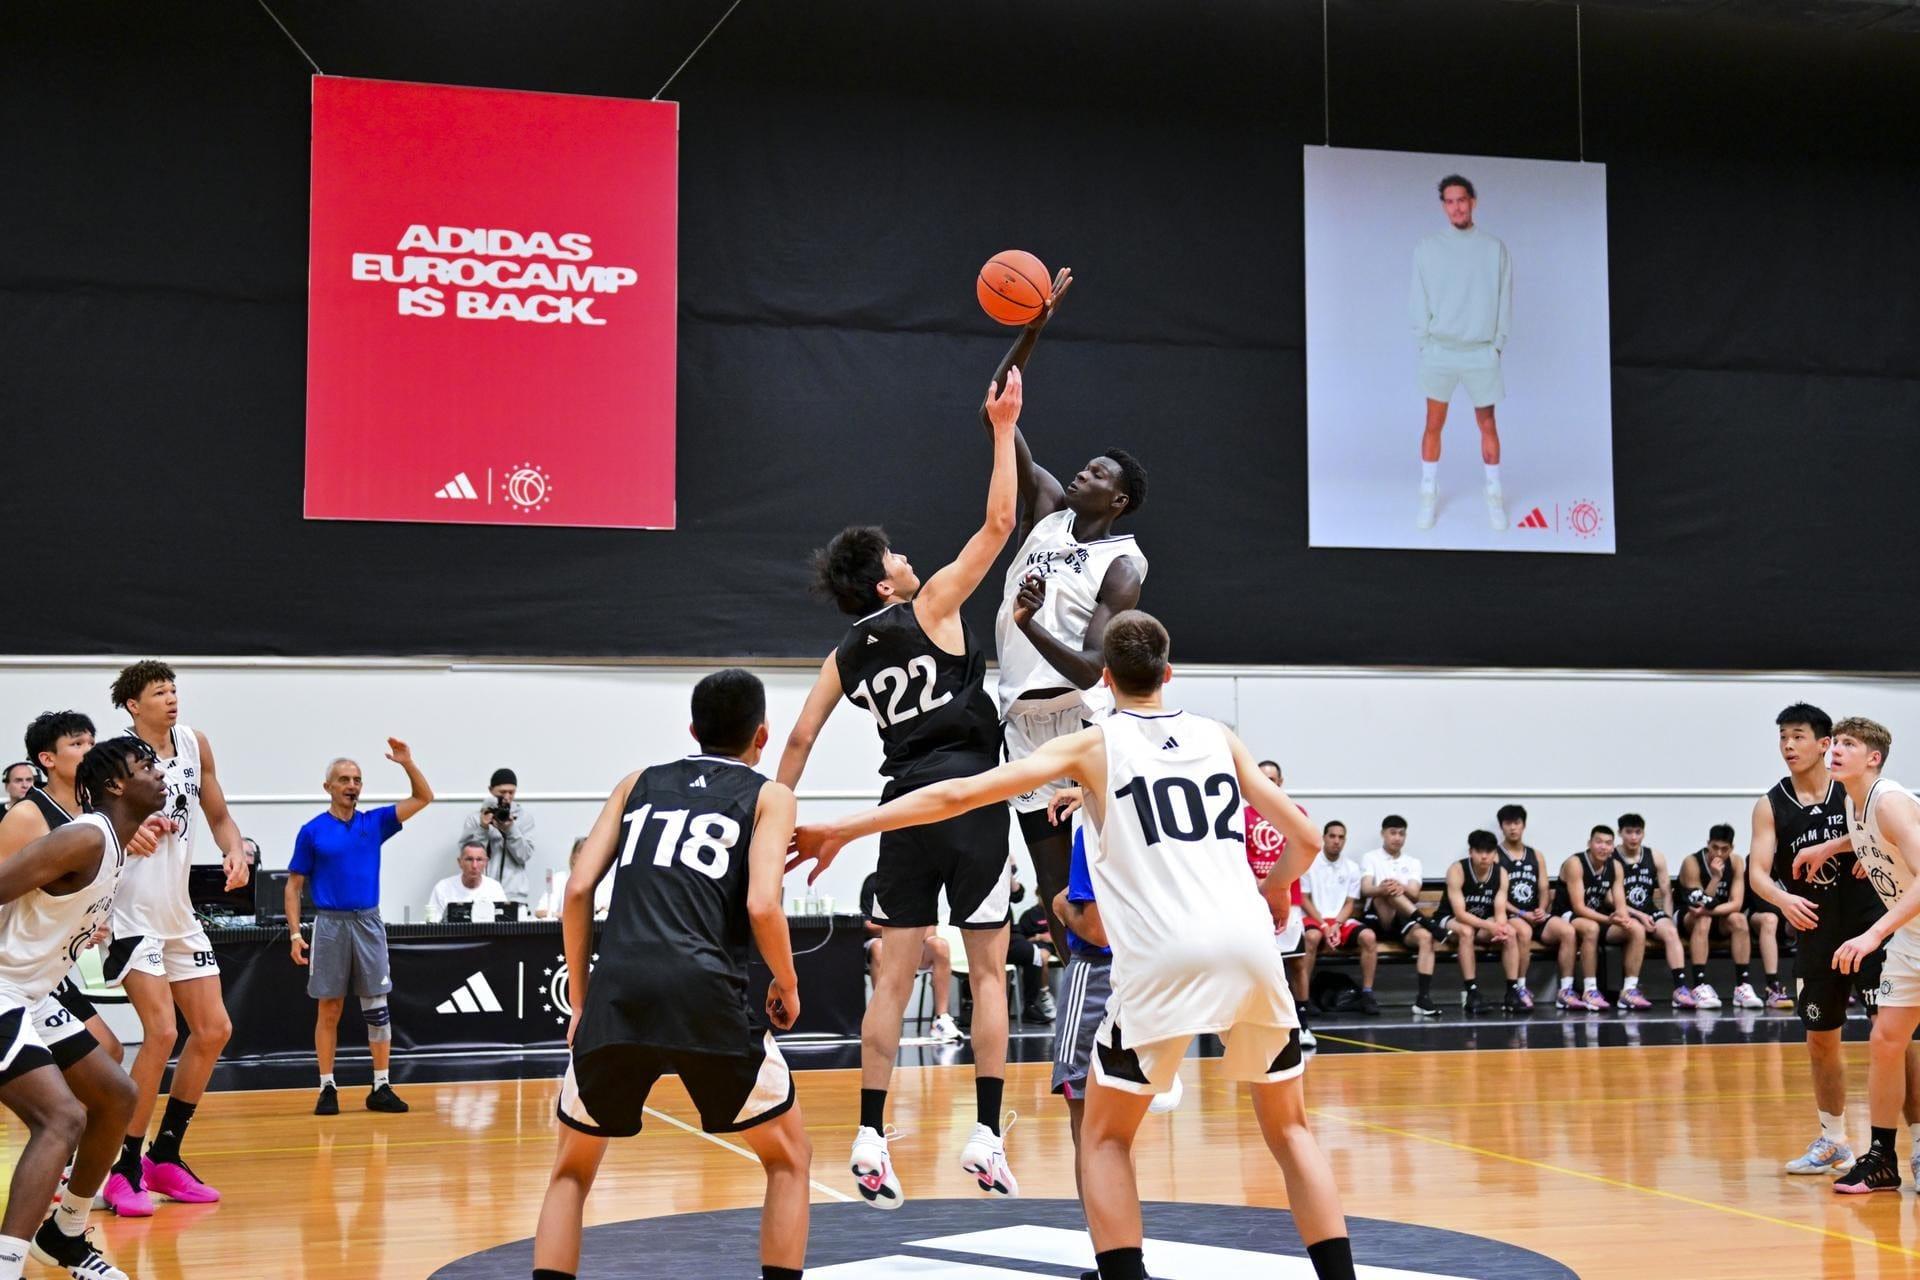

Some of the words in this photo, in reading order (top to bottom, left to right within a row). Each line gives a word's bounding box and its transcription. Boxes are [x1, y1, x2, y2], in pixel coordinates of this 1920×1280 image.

[396, 224, 593, 261] ADIDAS
[352, 252, 638, 293] EUROCAMP
[398, 286, 445, 317] IS
[850, 654, 954, 729] 122
[183, 767, 195, 778] 99
[1114, 772, 1245, 847] 102
[1826, 814, 1844, 826] 112
[620, 803, 740, 879] 118
[1790, 828, 1818, 853] TEAM
[193, 951, 216, 967] 99
